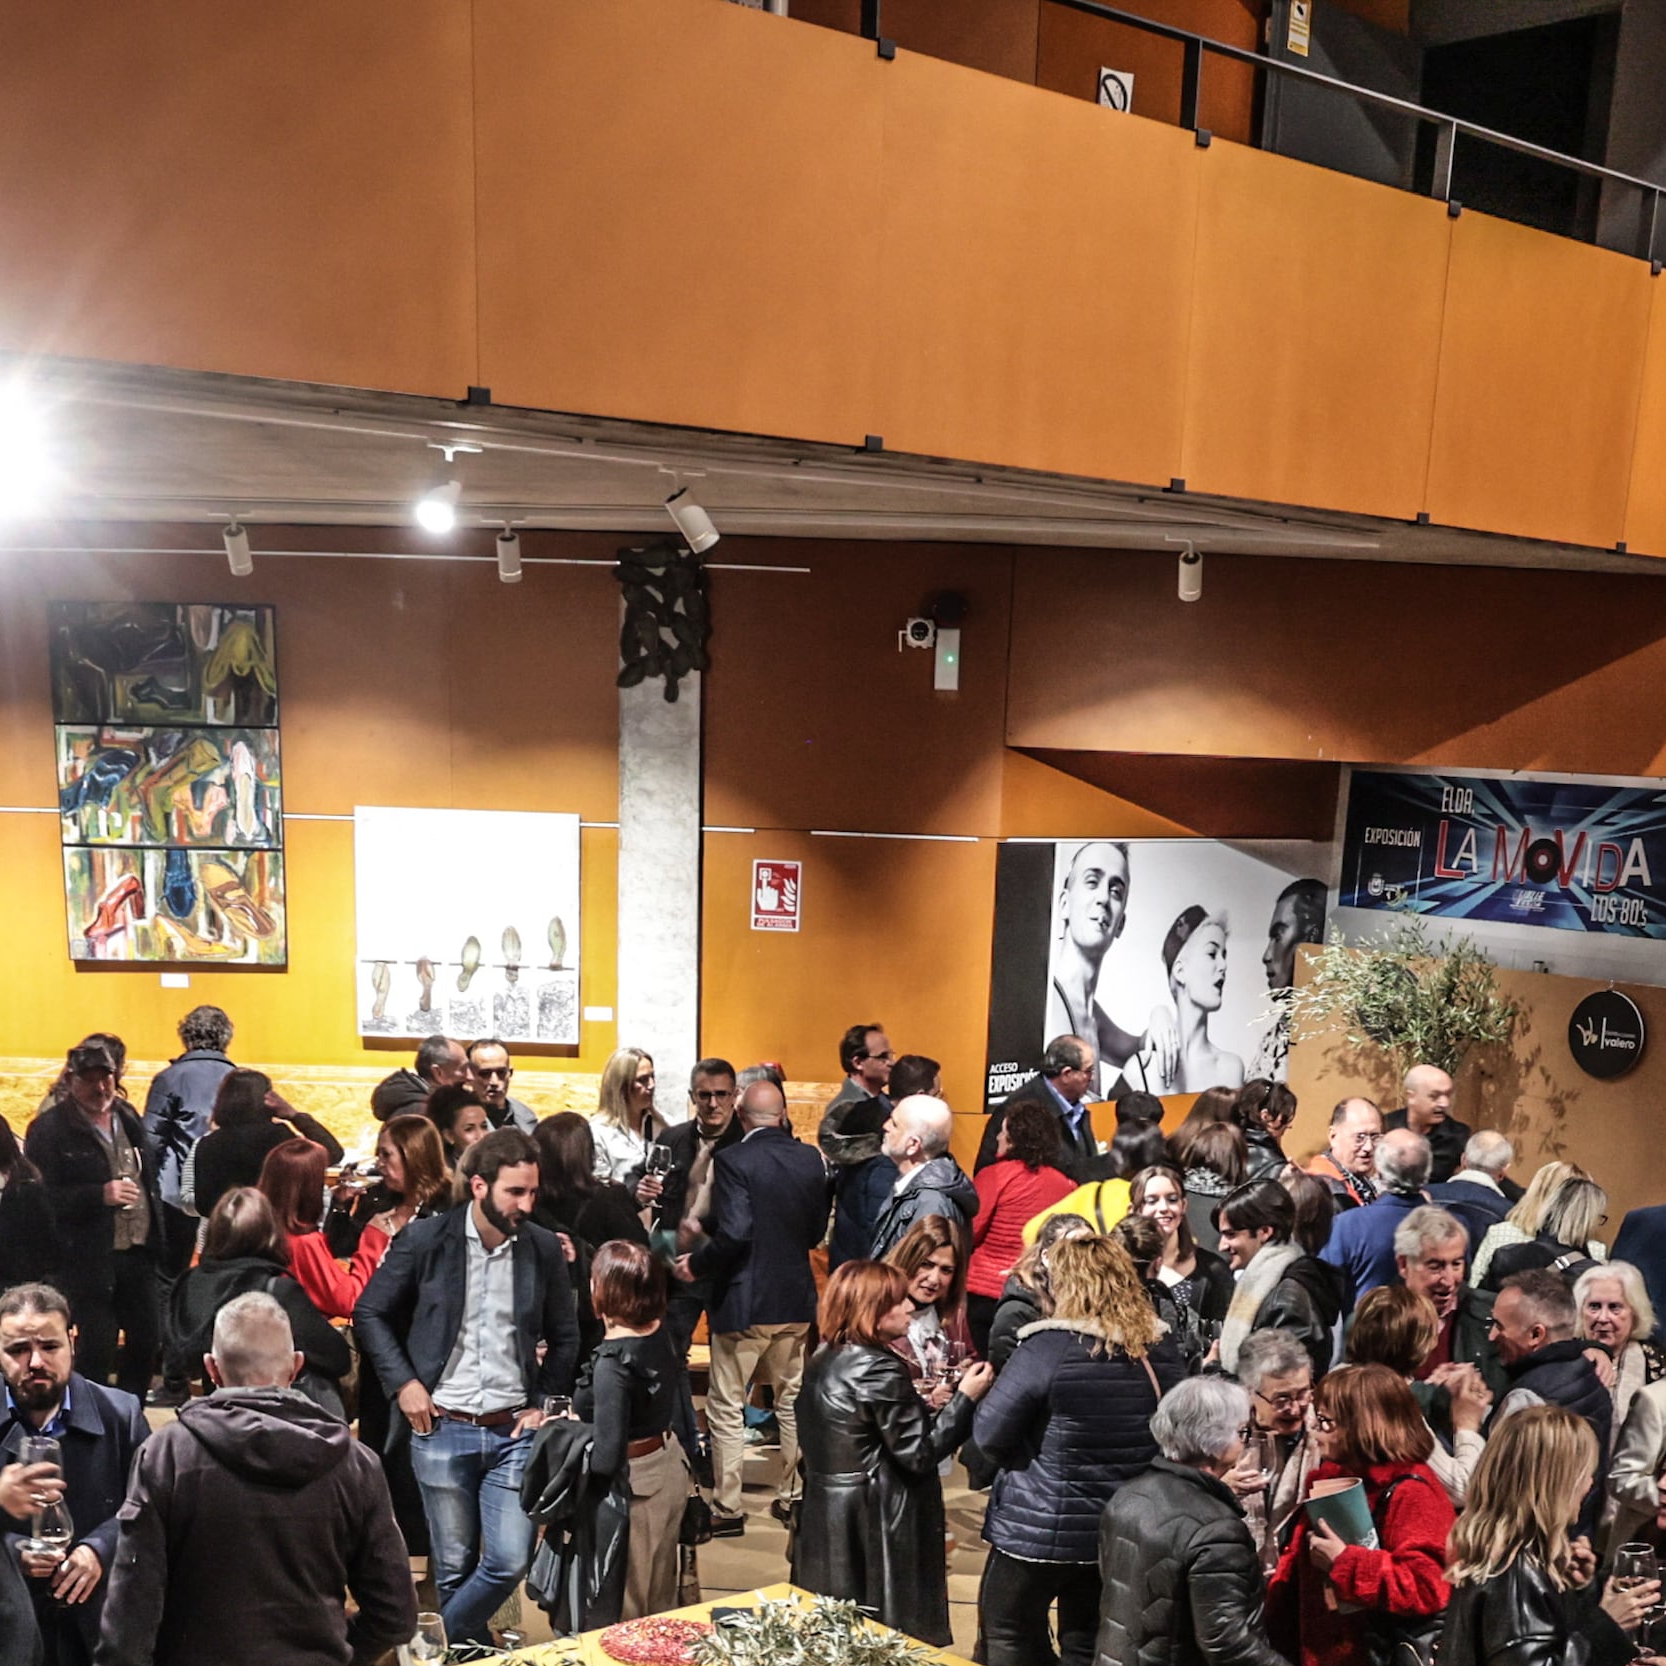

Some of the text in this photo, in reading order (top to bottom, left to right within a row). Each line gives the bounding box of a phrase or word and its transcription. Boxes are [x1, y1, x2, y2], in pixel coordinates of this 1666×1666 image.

[1441, 786, 1475, 815] ELDA,
[1364, 827, 1422, 848] EXPOSICIÓN
[1434, 820, 1653, 893] LA MOVIDA
[1590, 894, 1616, 924] LOS
[1604, 1037, 1636, 1050] valero
[989, 1062, 1019, 1074] ACCESO
